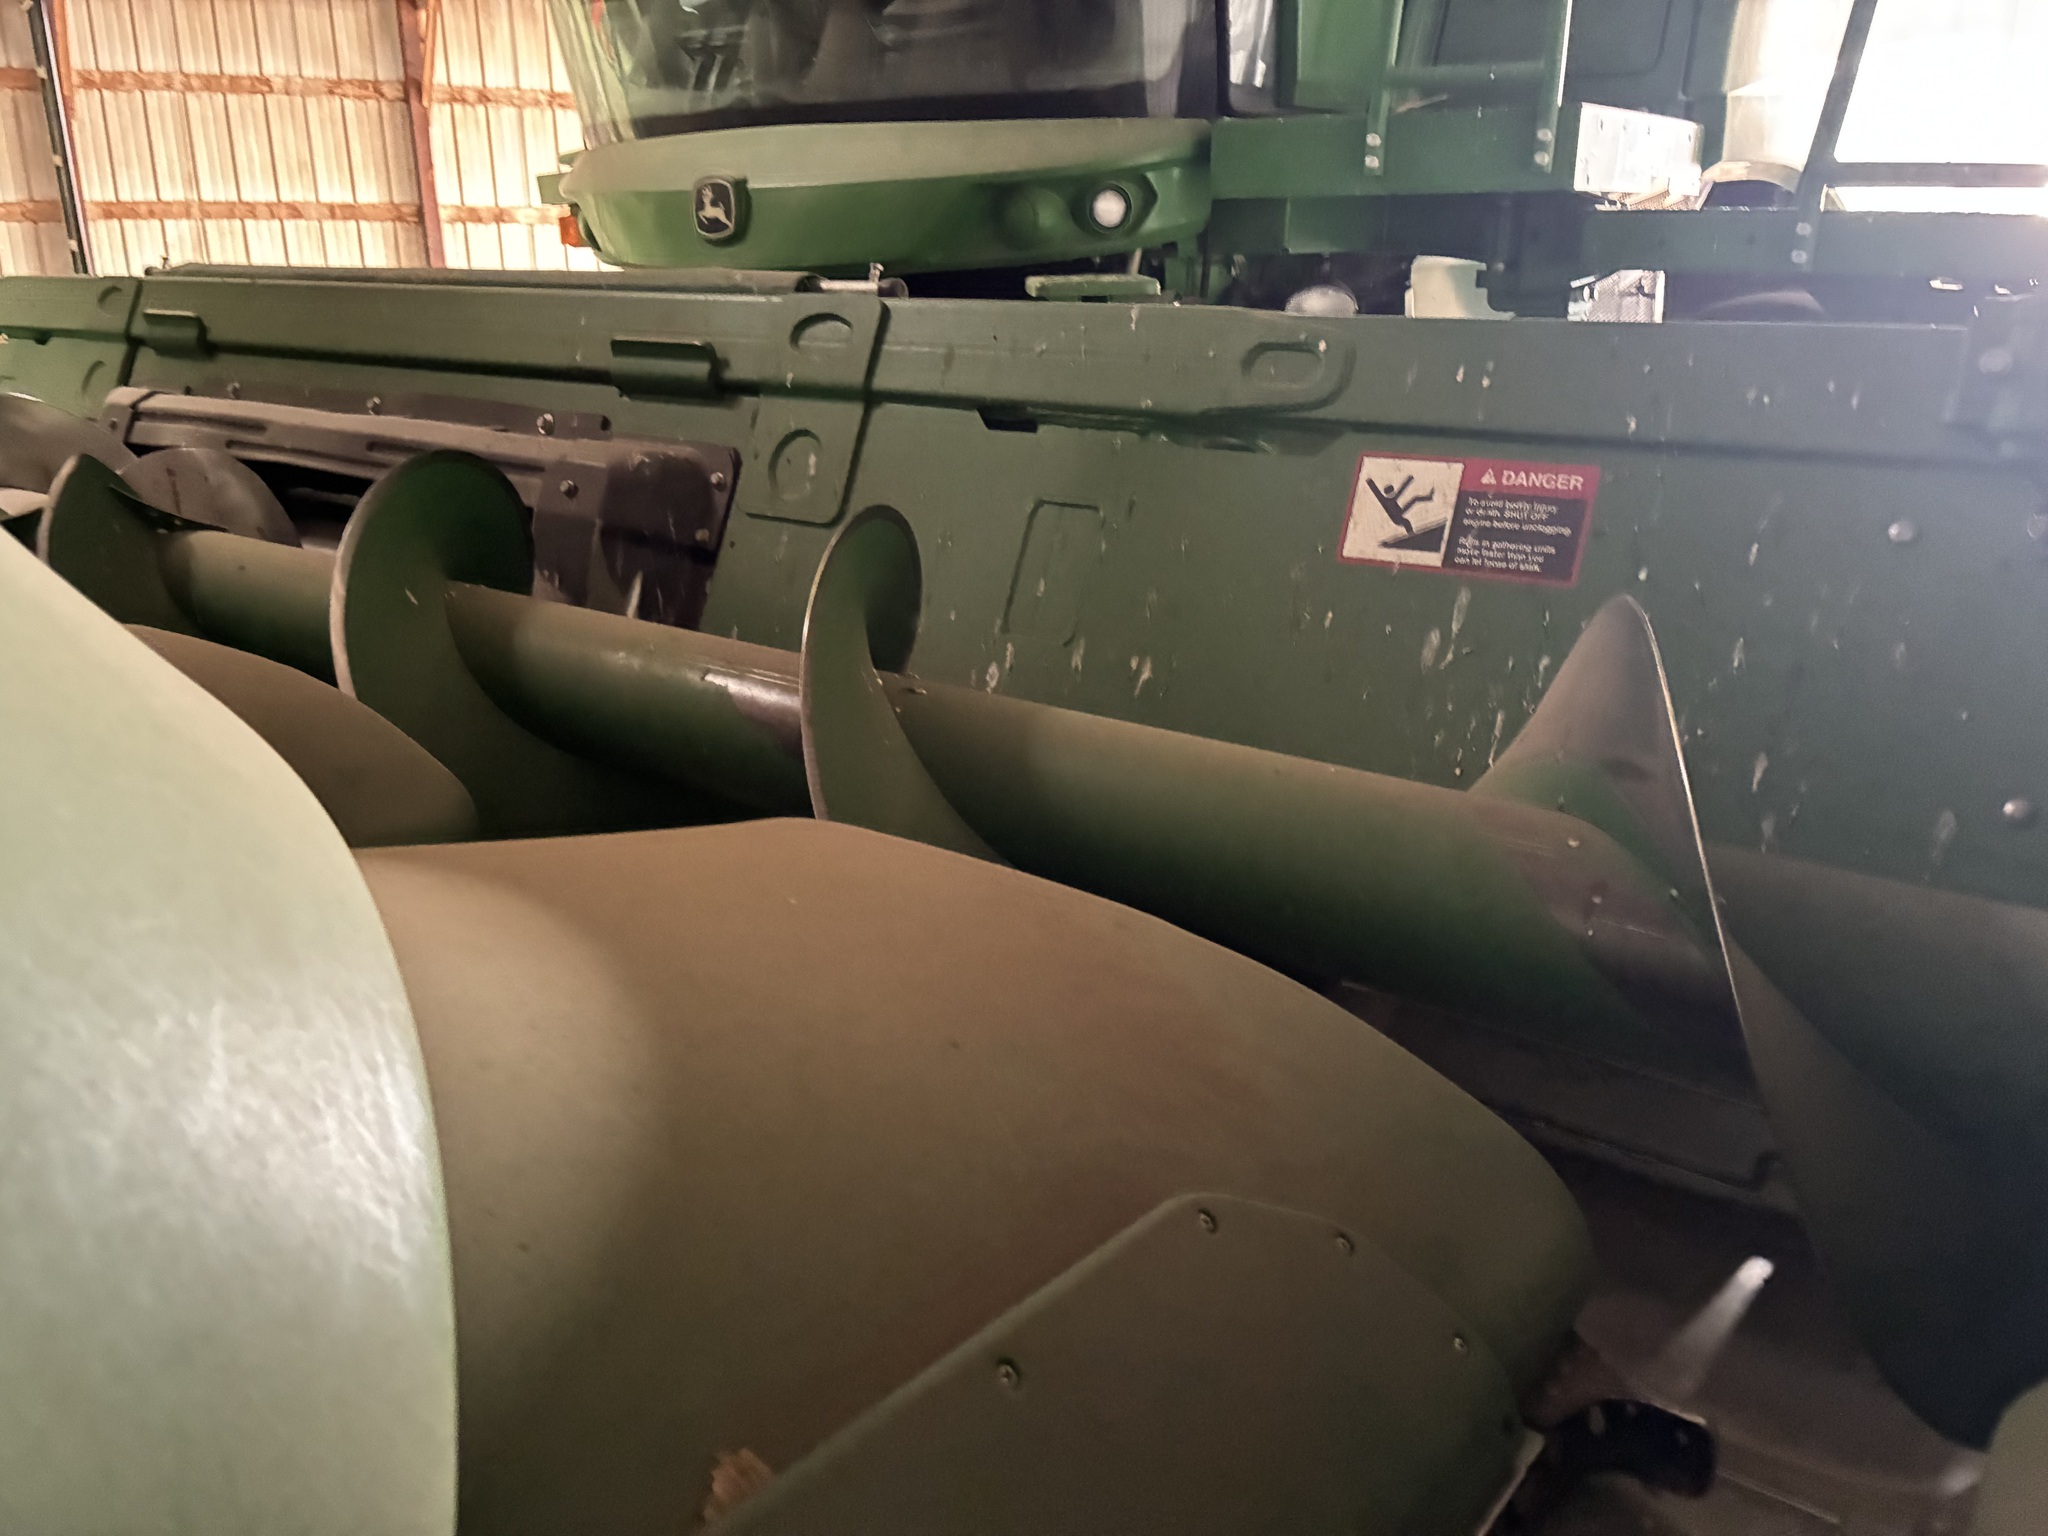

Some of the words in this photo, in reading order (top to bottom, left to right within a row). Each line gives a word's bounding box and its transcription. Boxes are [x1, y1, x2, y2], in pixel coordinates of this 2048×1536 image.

[1501, 469, 1584, 491] DANGER
[1481, 498, 1503, 509] avoid
[1505, 499, 1530, 512] bodily
[1503, 510, 1528, 520] SHUT
[1530, 512, 1550, 522] OFF
[1463, 518, 1492, 529] engine
[1492, 519, 1520, 531] before
[1492, 540, 1532, 553] gathering
[1534, 545, 1556, 555] units
[1481, 548, 1506, 559] faster
[1507, 551, 1526, 561] than
[1528, 553, 1545, 563] you
[1484, 559, 1508, 569] loose
[1508, 561, 1518, 570] of
